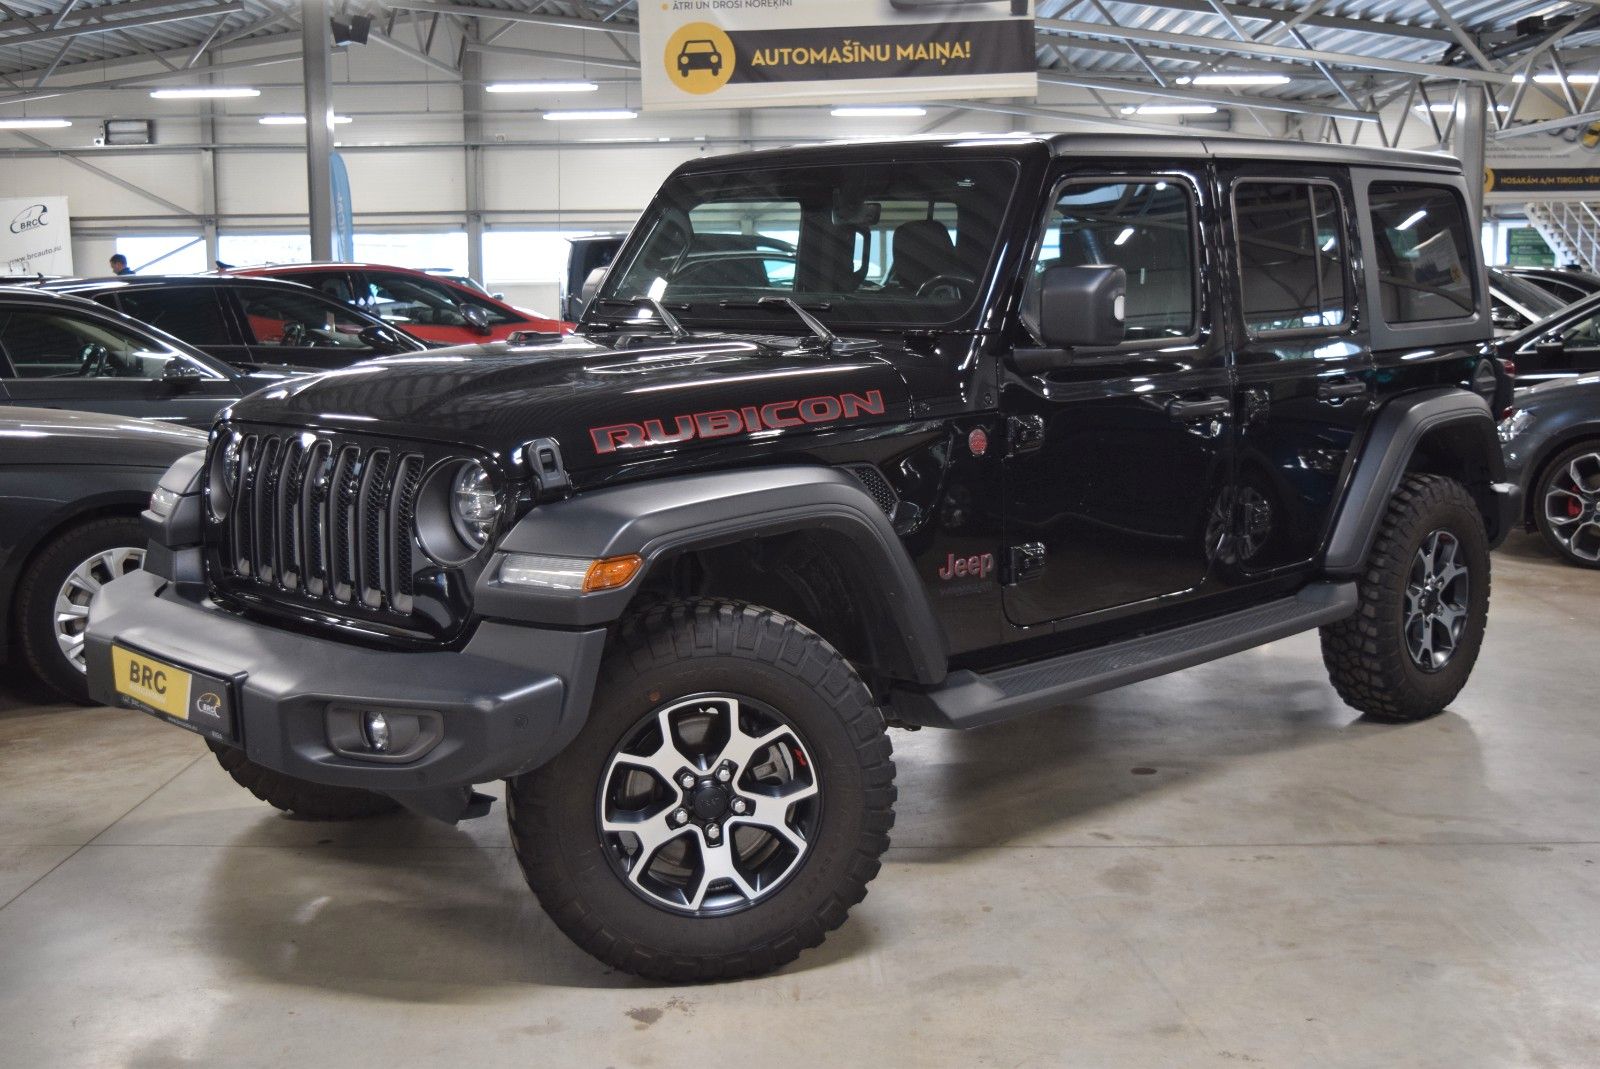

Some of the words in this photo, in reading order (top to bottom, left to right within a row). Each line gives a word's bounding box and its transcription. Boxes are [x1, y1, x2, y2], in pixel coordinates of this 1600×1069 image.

[696, 0, 710, 9] UN
[751, 40, 891, 66] AUTOMAŠĪNU
[896, 41, 971, 66] MAIŅA!
[1556, 176, 1584, 185] TIRGUS
[20, 219, 38, 230] BRC
[589, 389, 885, 454] RUBICON
[939, 553, 994, 580] Jeep
[130, 660, 167, 694] BRC
